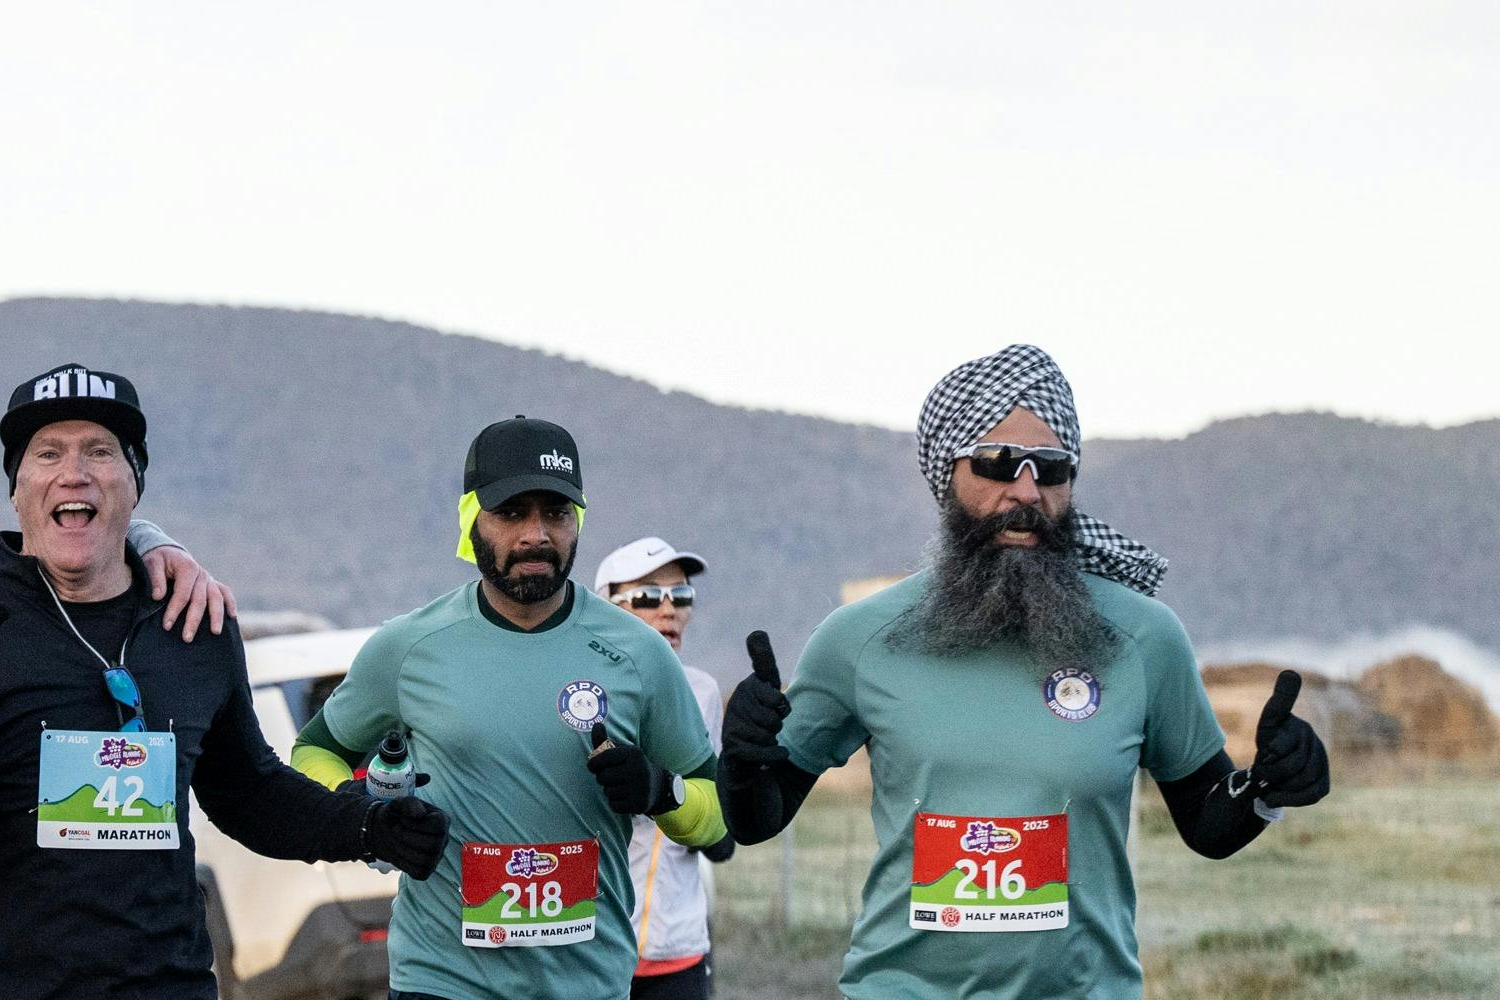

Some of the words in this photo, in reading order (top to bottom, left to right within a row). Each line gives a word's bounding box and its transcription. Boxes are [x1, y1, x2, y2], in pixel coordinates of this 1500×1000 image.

[34, 372, 116, 401] RUN
[588, 640, 621, 662] 2XU
[1052, 667, 1093, 684] RPD
[566, 682, 603, 697] RPD
[562, 710, 587, 729] SPORTS
[587, 714, 604, 728] CUB
[55, 735, 65, 743] 17
[67, 735, 89, 744] AUG
[148, 737, 165, 746] 2025
[93, 775, 144, 817] 42
[926, 818, 935, 826] 17
[936, 819, 957, 828] AUG
[1022, 819, 1049, 831] 2025
[97, 829, 171, 840] MARATHON
[473, 847, 481, 855] 17
[483, 848, 501, 856] AUG
[560, 844, 583, 855] 2025
[953, 858, 1026, 900] 216
[500, 880, 563, 919] 218
[965, 911, 997, 921] HALF
[1000, 908, 1064, 921] MARATHON
[510, 929, 538, 938] HALF
[541, 923, 592, 937] MARATHON
